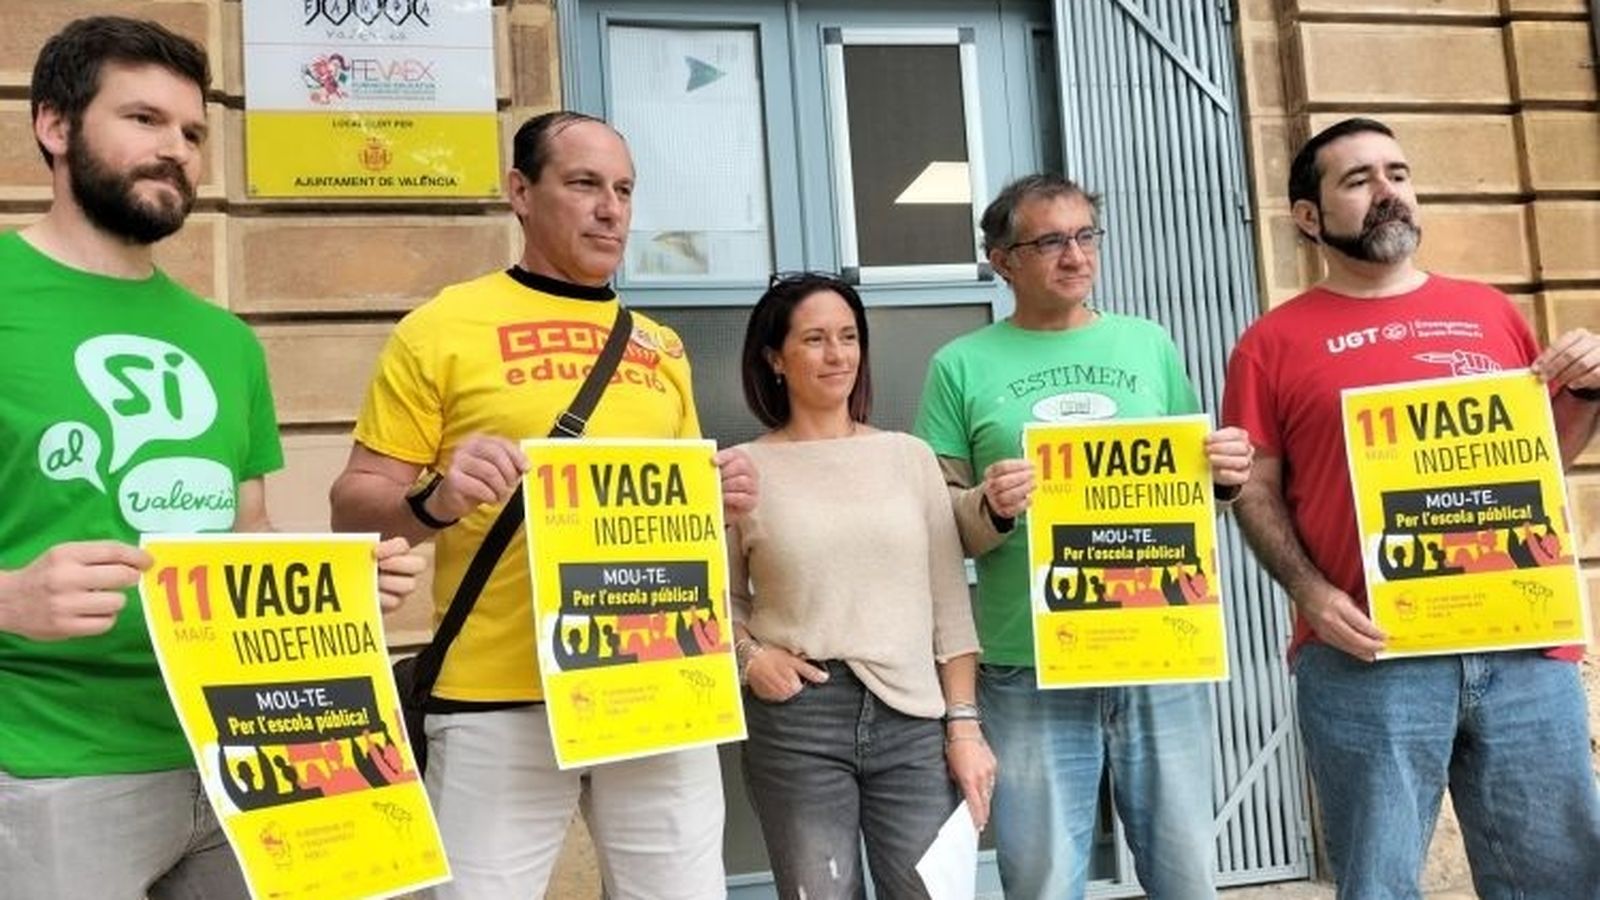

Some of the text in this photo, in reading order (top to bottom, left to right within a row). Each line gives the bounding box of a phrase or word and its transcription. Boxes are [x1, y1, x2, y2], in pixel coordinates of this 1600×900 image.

[294, 175, 375, 187] AJUNTAMENT
[378, 175, 395, 187] DE
[1327, 327, 1379, 353] UGT
[1007, 364, 1137, 398] ESTIMEM
[1356, 394, 1514, 447] 11 VAGA
[46, 428, 84, 472] al
[1037, 438, 1176, 481] 11 VAGA
[1413, 436, 1550, 475] INDEFINIDA
[537, 463, 688, 510] 11 VAGA
[1085, 480, 1205, 512] INDEFINIDA
[1425, 489, 1498, 509] MOU-TE.
[593, 513, 718, 547] INDEFINIDA
[1395, 503, 1533, 529] Per l'escola pública!
[1091, 527, 1157, 544] MOU-TE.
[1063, 544, 1185, 562] Per l'escola pública!
[602, 567, 672, 586] MOU-TE.
[157, 562, 342, 623] 11 VAGA
[572, 585, 699, 607] Per l'escola pública!
[232, 619, 379, 666] INDEFINIDA
[255, 687, 334, 711] MOU-TE.
[228, 706, 370, 736] Per l'escola pública!
